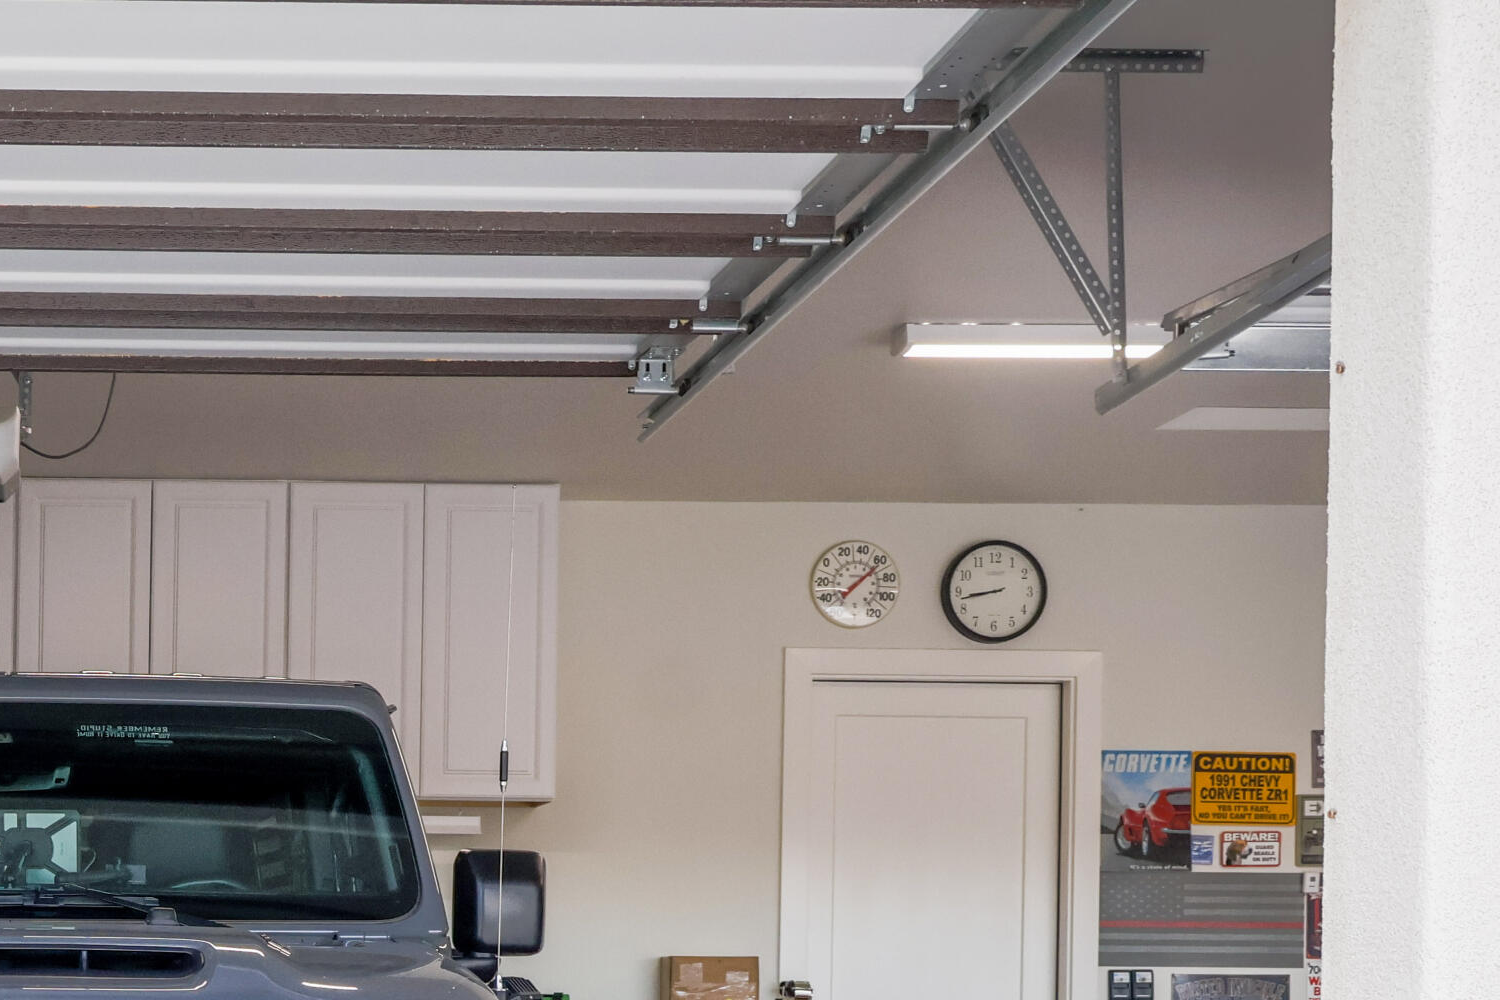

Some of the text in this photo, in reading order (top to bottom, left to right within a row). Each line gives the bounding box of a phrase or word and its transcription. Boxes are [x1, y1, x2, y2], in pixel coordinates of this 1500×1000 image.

[838, 547, 850, 556] 20
[856, 545, 869, 555] 40
[822, 558, 830, 567] 0
[873, 555, 887, 565] 60
[973, 557, 983, 568] 11
[989, 552, 1002, 563] 12
[1010, 557, 1014, 568] 1
[882, 573, 896, 582] 80
[960, 570, 971, 581] 10
[1021, 568, 1028, 579] 2
[814, 577, 829, 586] -20
[879, 592, 895, 601] 100
[955, 586, 962, 597] 9
[1026, 586, 1033, 597] 3
[816, 593, 832, 602] -40
[960, 603, 967, 614] 8
[1020, 604, 1028, 615] 4
[973, 616, 979, 627] 7
[990, 621, 997, 632] 6
[1008, 616, 1015, 627] 5
[1103, 753, 1188, 773] CORVETTE
[1199, 757, 1290, 771] CAUTION!
[1209, 774, 1281, 787] 1991 CHEVY
[1200, 787, 1288, 800] CORVETTE ZR1
[1224, 832, 1278, 841] BEWARE!
